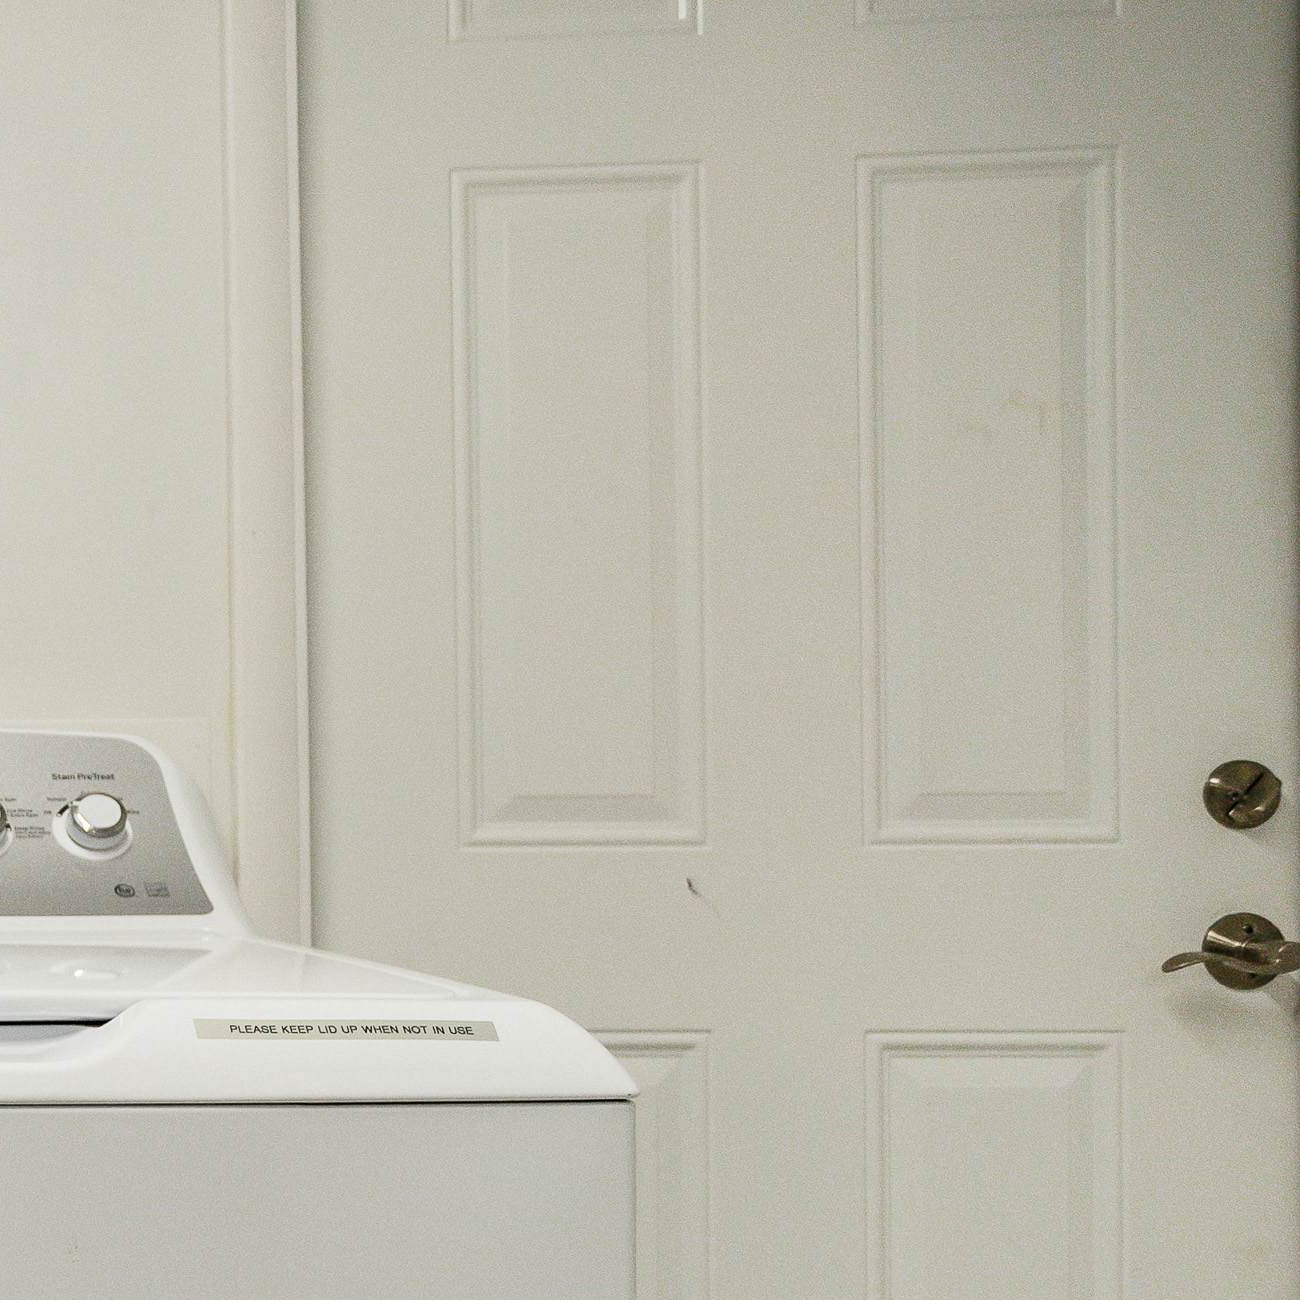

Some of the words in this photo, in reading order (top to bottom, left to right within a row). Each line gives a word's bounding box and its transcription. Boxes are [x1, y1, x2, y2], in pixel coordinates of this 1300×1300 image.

[51, 773, 76, 781] Stain
[229, 1024, 278, 1034] PLEASE
[281, 1025, 314, 1034] KEEP
[318, 1025, 338, 1034] LID
[341, 1025, 358, 1034] UP
[361, 1025, 400, 1034] WHEN
[403, 1026, 430, 1034] NOT
[432, 1026, 445, 1035] IN
[449, 1026, 475, 1036] USE
